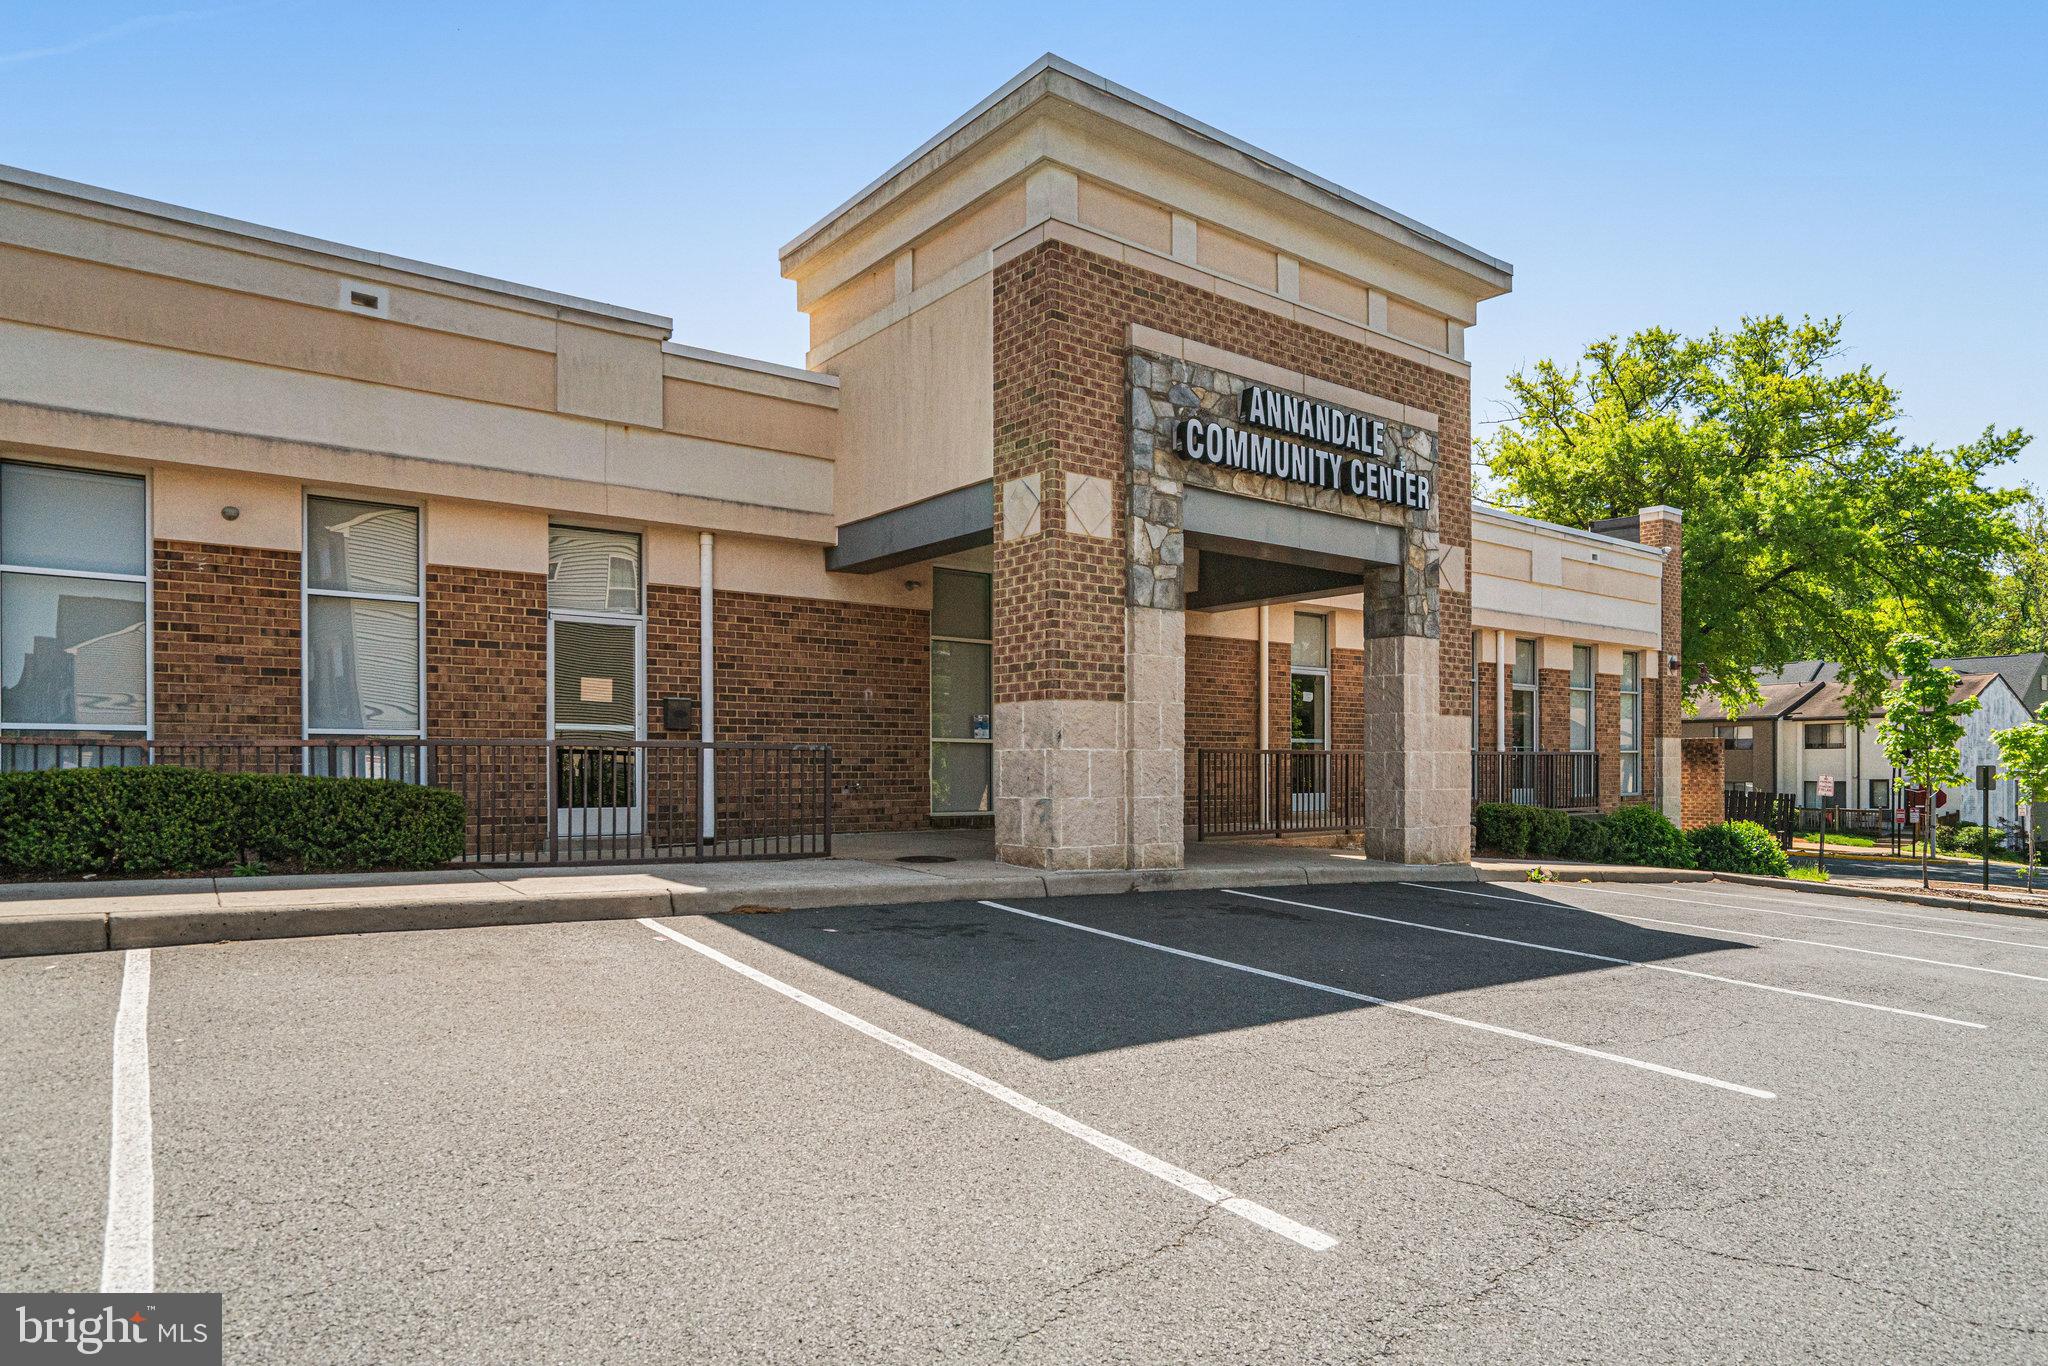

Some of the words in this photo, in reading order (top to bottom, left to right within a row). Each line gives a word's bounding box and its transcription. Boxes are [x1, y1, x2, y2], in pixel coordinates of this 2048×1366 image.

[1248, 386, 1384, 457] ANNANDALE
[1186, 418, 1343, 490] COMMUNITY
[1350, 459, 1430, 510] CENTER
